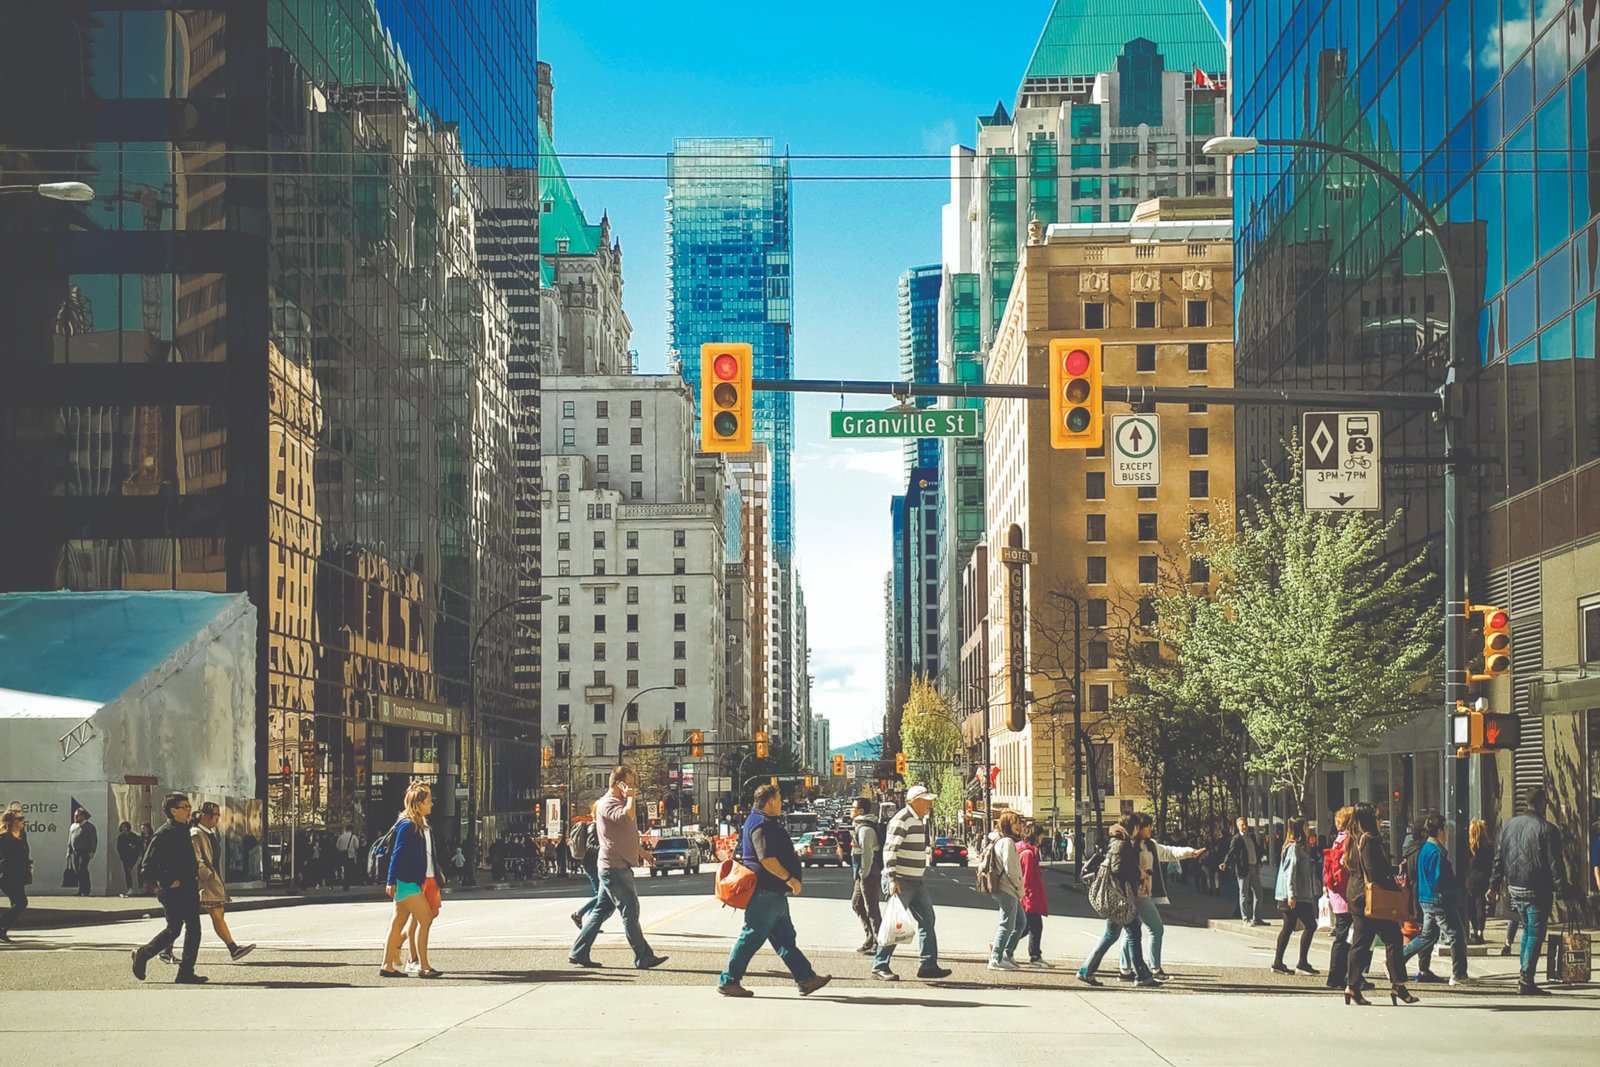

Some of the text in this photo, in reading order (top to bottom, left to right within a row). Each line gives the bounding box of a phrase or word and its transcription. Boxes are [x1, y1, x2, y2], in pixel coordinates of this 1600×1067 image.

[842, 414, 965, 434] Granville St
[1355, 438, 1366, 451] 3
[1119, 462, 1153, 471] EXCEPT
[1122, 472, 1152, 481] BUSES
[1004, 550, 1029, 561] HOTEL
[1011, 569, 1023, 710] GEORGIA
